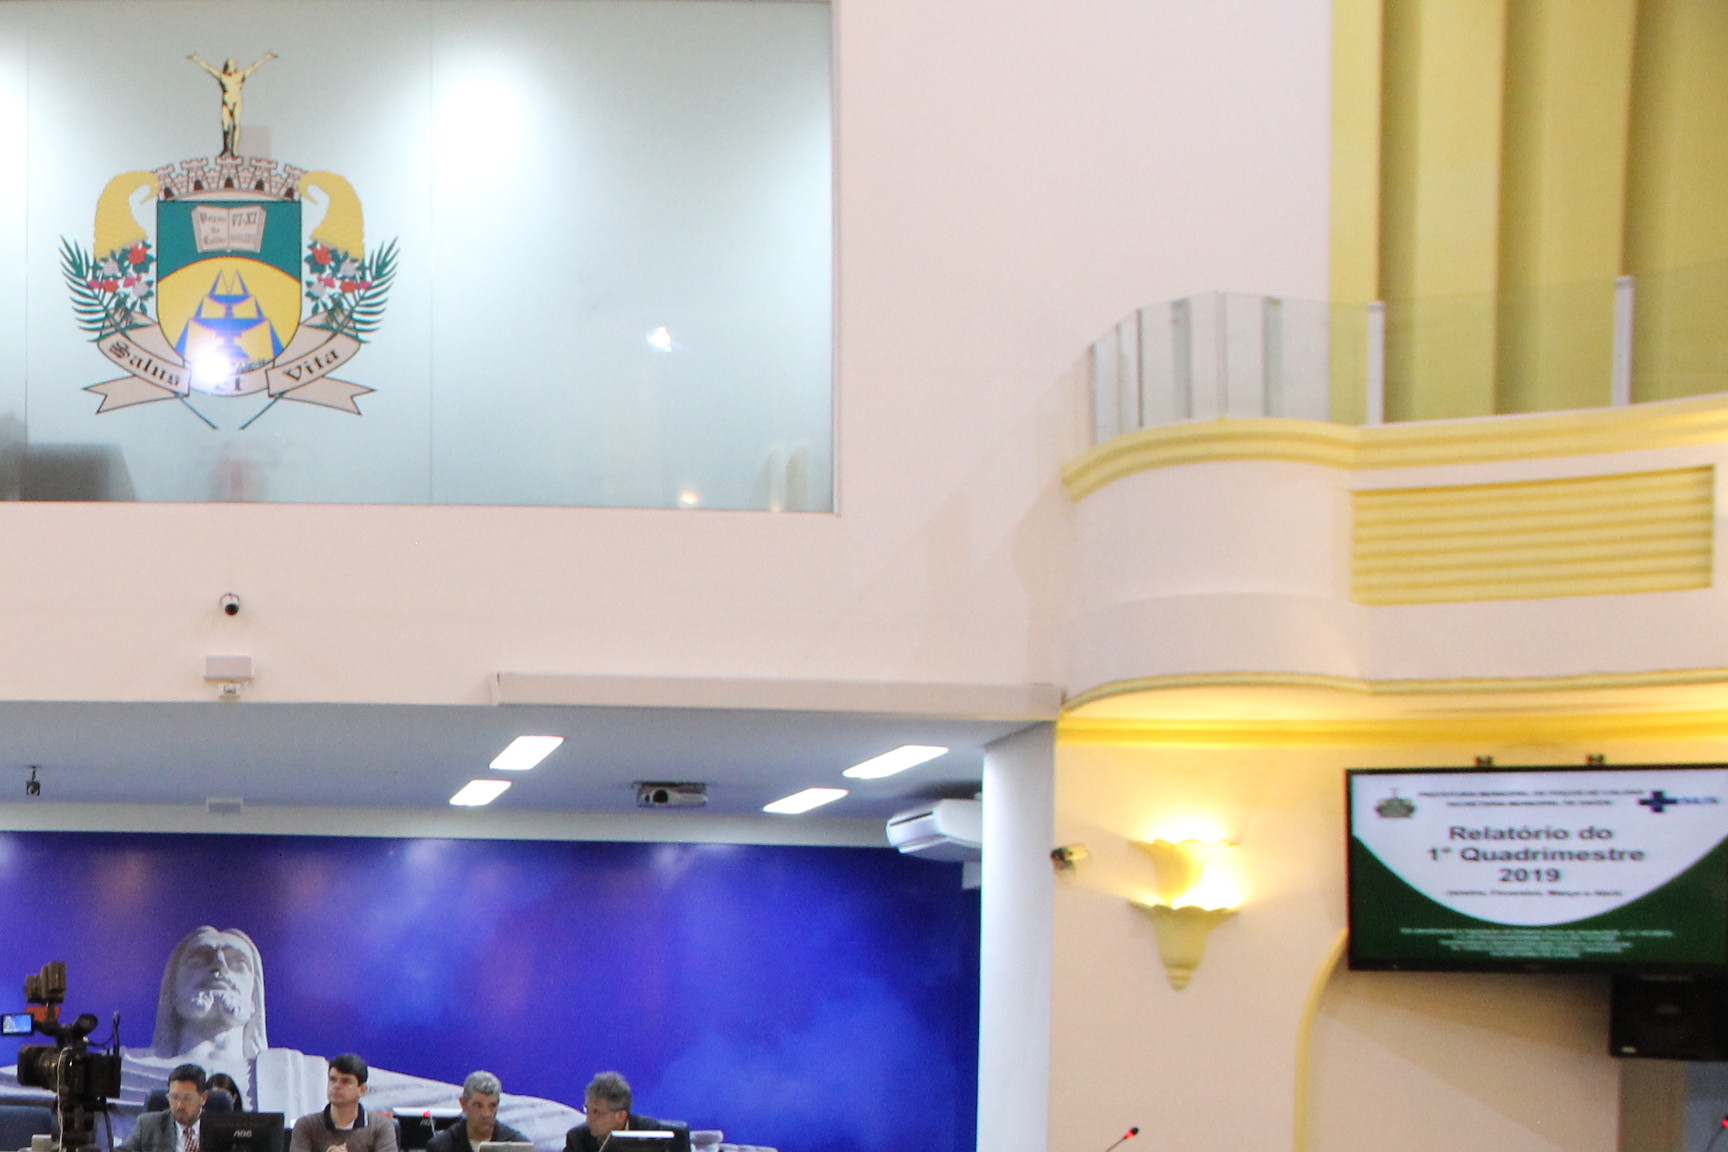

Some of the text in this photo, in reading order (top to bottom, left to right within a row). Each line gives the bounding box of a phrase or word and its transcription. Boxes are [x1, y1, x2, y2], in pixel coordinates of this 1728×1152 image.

[282, 348, 339, 382] Vita
[1449, 826, 1613, 841] Relatório do
[1460, 848, 1646, 862] Quadrimestre
[1499, 868, 1562, 882] 2019
